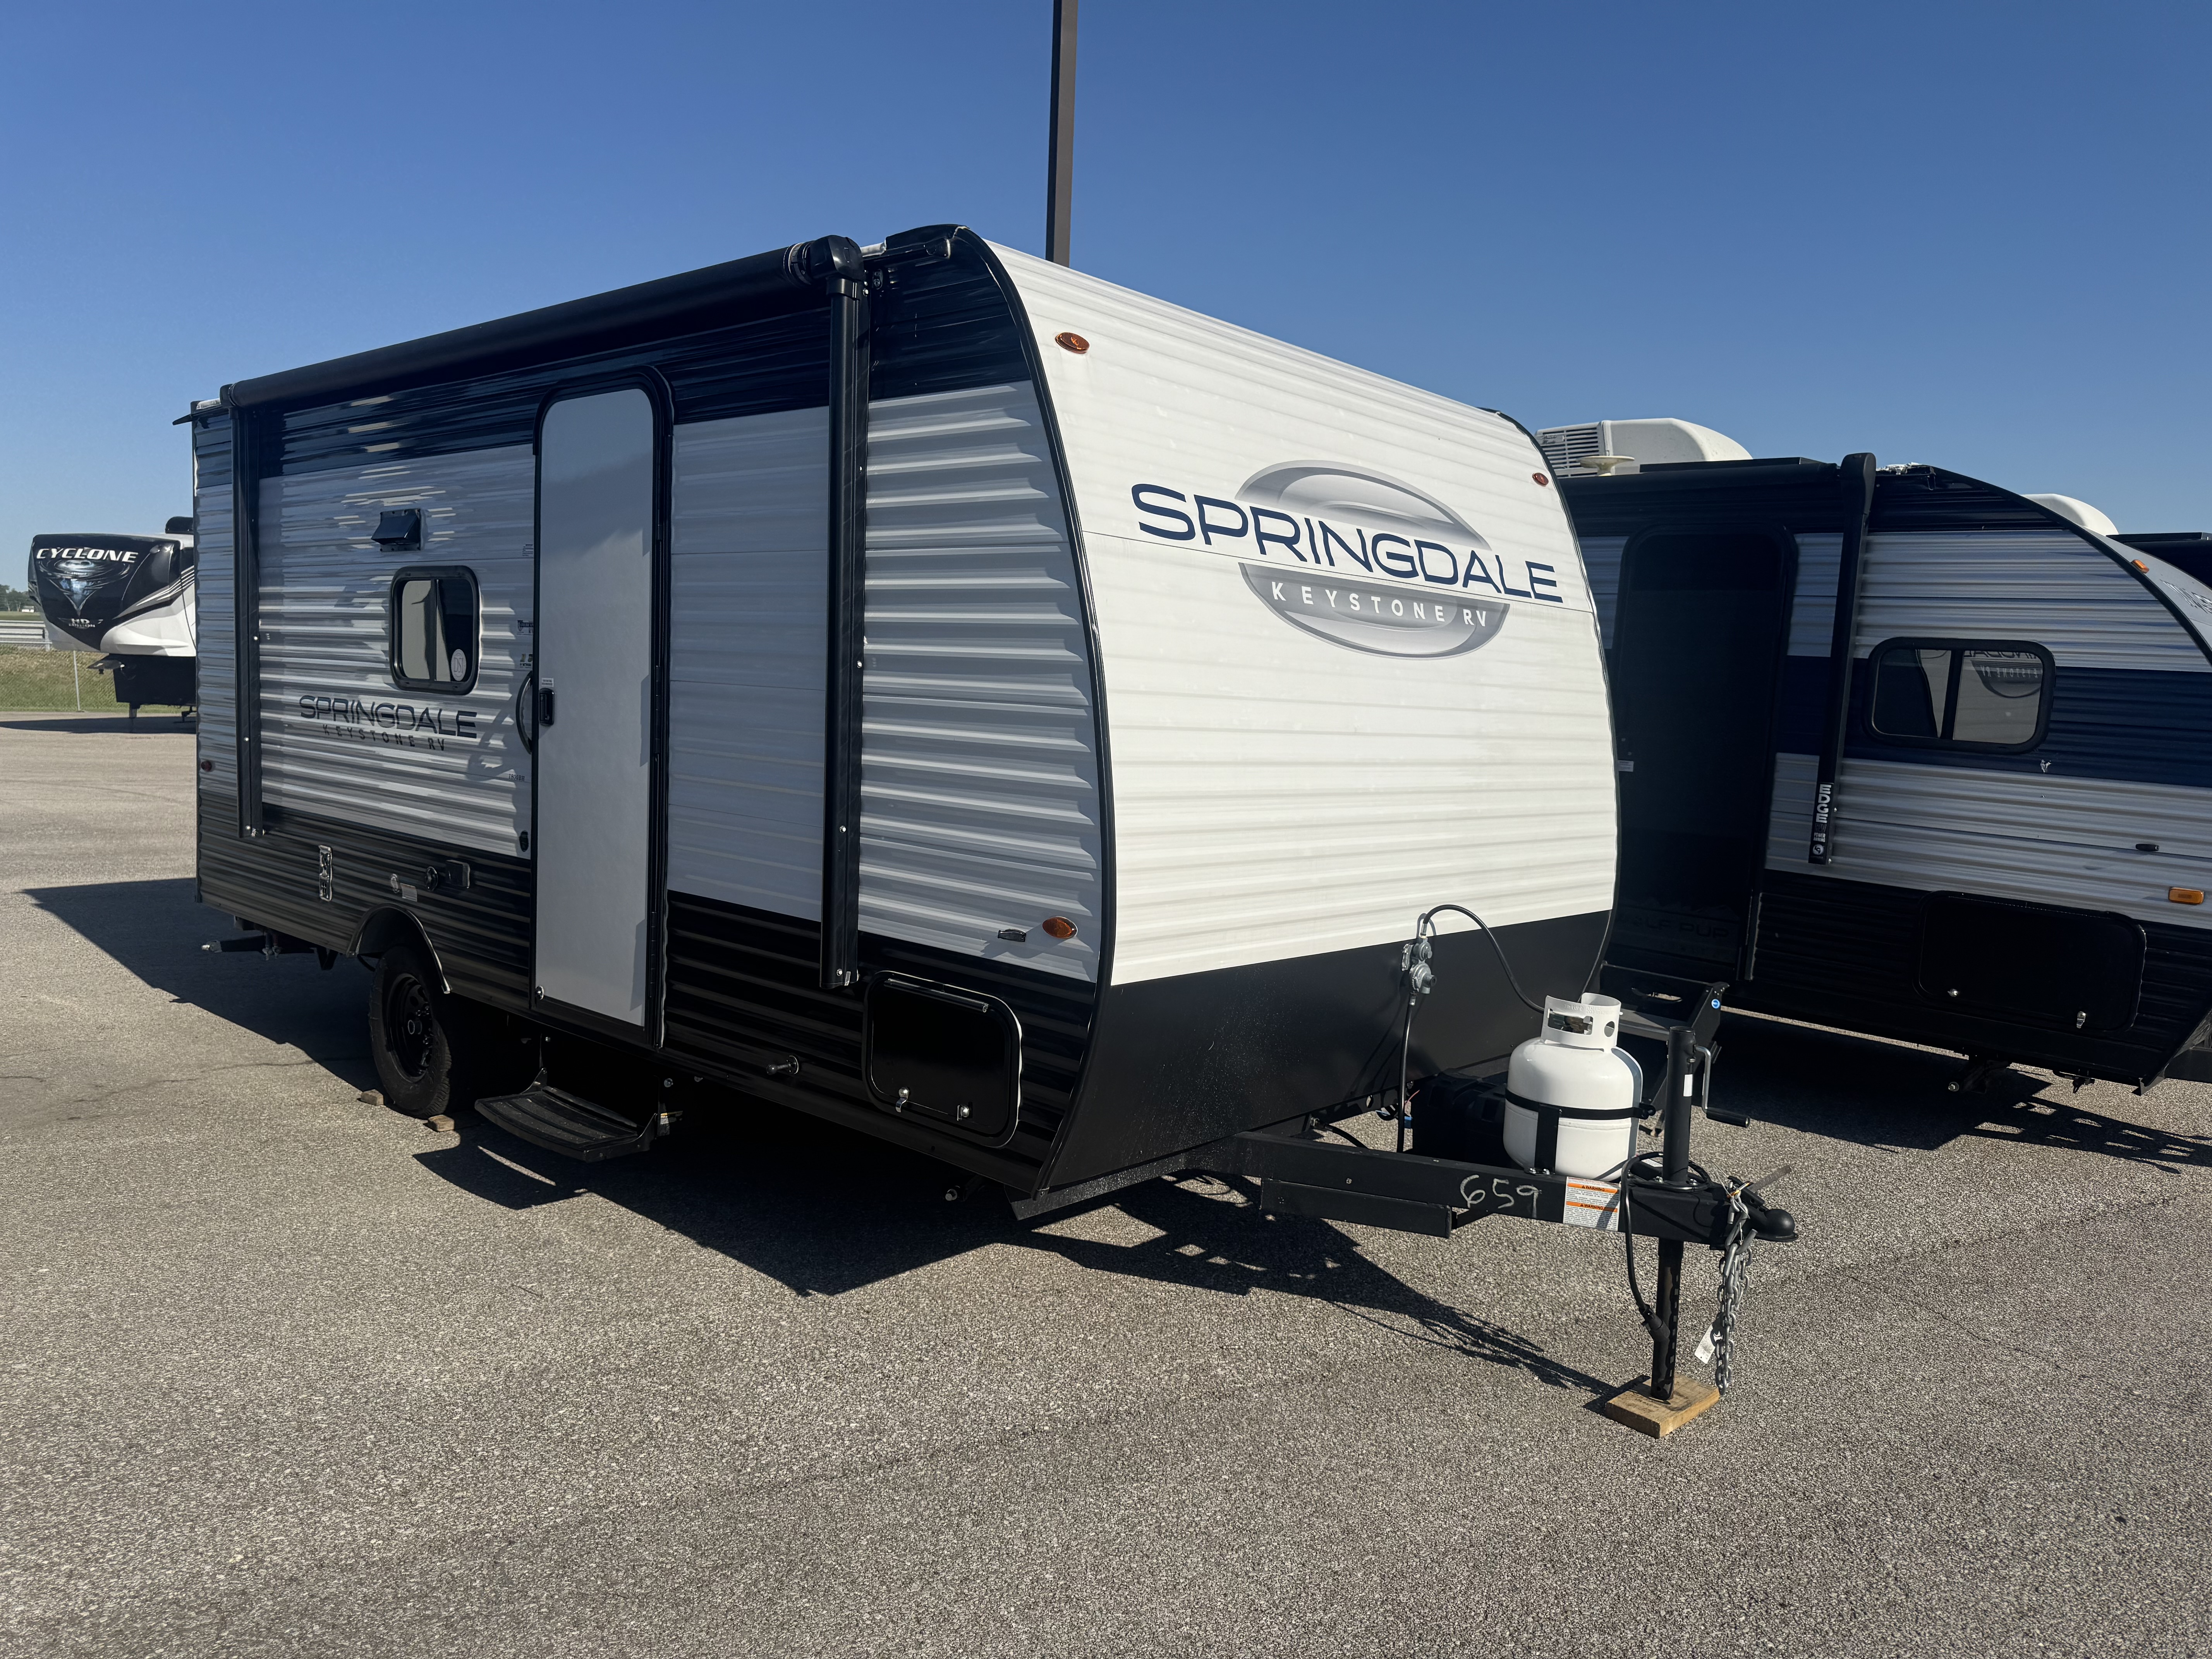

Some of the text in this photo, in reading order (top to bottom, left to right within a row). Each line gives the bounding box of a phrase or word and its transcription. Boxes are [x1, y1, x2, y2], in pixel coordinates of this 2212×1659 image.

[36, 548, 138, 563] CYCLONE
[1131, 483, 1563, 603] SPRINGDALE
[1272, 581, 1487, 627] KEYSTONE RV
[299, 695, 477, 738] SPRINGDALE
[323, 724, 445, 750] KEYSTONE RV
[1816, 784, 1832, 823] EDGE
[1460, 1175, 1540, 1218] 659
